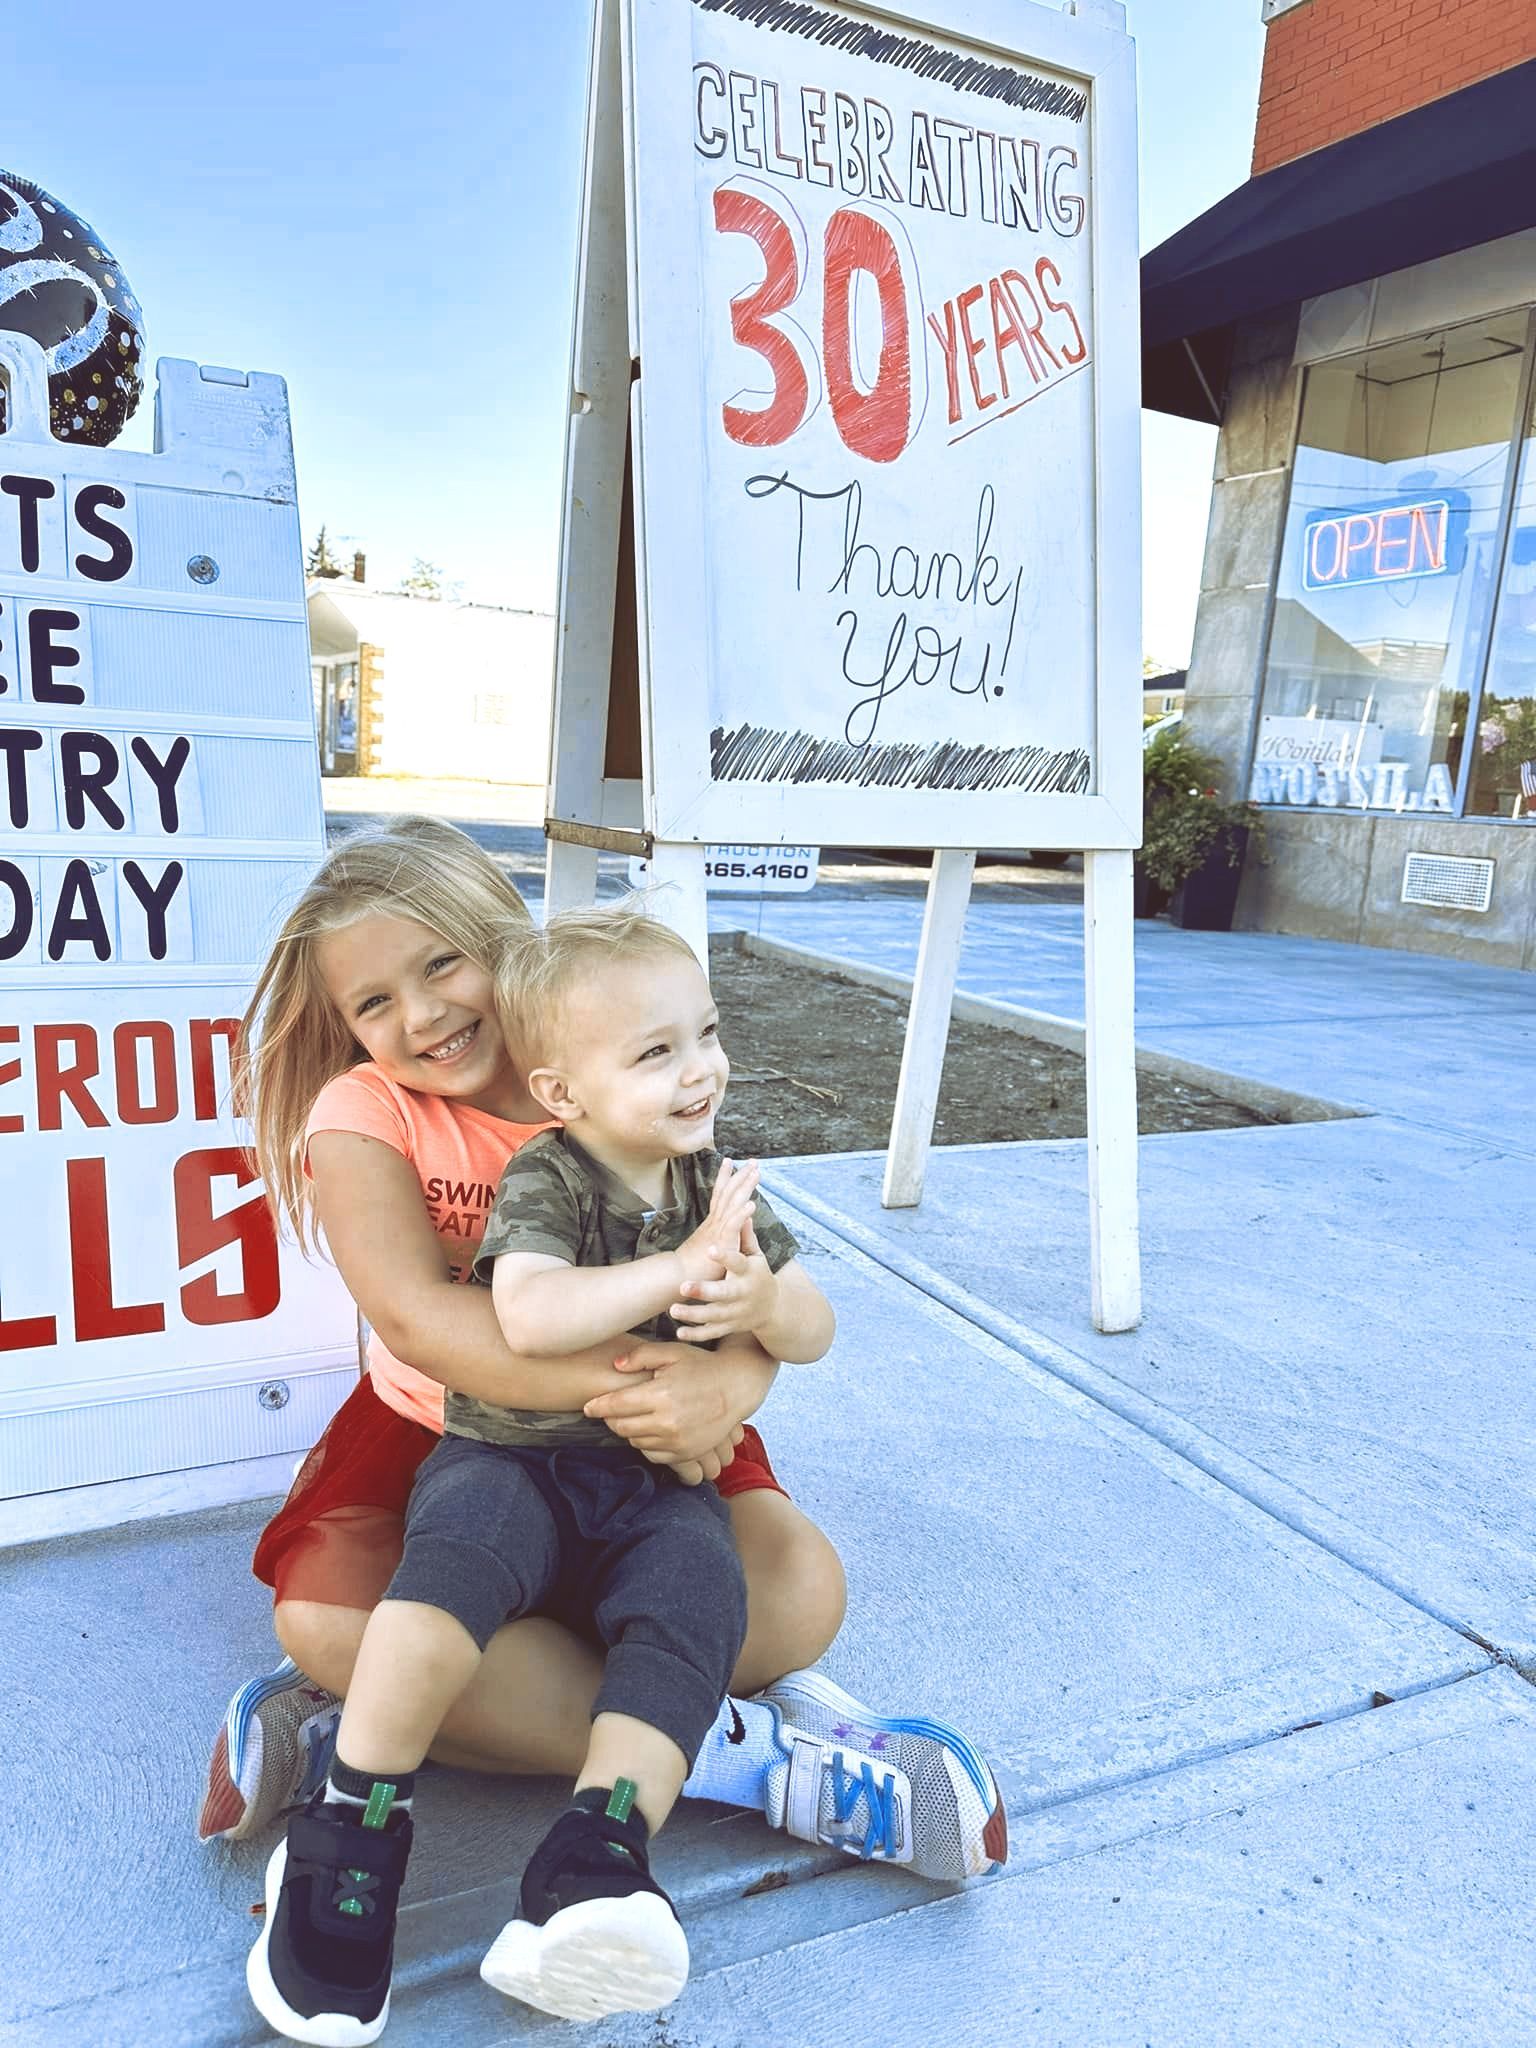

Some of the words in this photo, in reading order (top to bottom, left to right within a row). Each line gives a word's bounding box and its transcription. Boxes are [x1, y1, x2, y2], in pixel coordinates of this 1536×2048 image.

[692, 61, 1084, 238] CELEBRATING
[713, 176, 926, 463] 30
[927, 257, 1087, 424] YEARS
[744, 470, 1013, 607] Thank
[1310, 507, 1445, 581] OPEN
[0, 603, 85, 705] E
[837, 566, 1022, 748] You!
